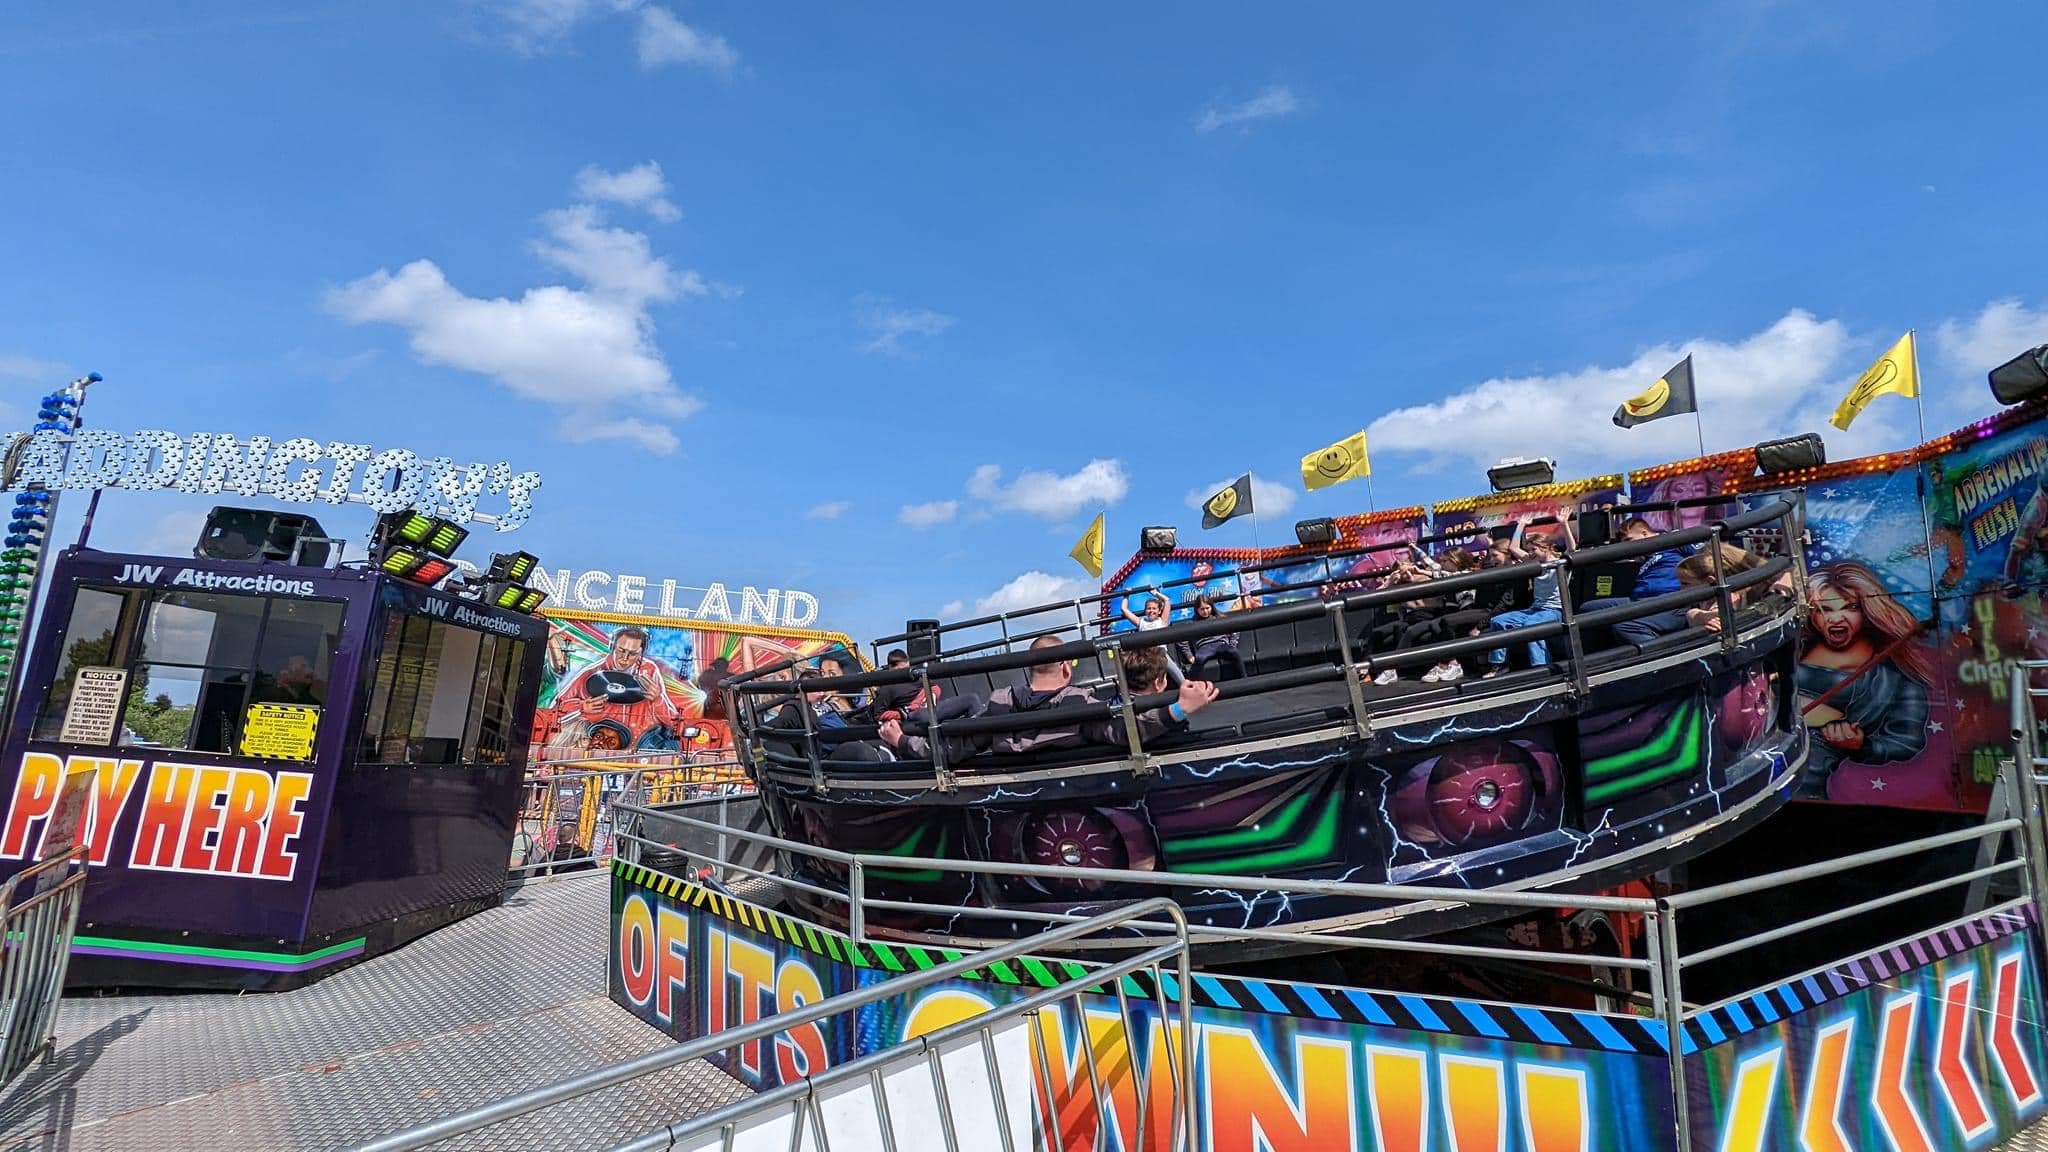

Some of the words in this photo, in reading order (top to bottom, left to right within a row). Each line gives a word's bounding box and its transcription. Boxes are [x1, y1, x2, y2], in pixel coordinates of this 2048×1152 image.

[0, 429, 542, 533] ADDINGTON'S
[1972, 496, 2019, 551] RUSH
[113, 563, 165, 585] JW
[173, 568, 315, 595] Attractions
[662, 578, 819, 628] LAND
[419, 597, 450, 618] JW
[453, 605, 521, 635] Attractions
[86, 672, 118, 680] NOTICE
[261, 711, 282, 719] SAFETY
[0, 751, 145, 867] PAY
[128, 761, 314, 882] HERE
[620, 894, 689, 1022] OF
[707, 926, 829, 1086] ITS
